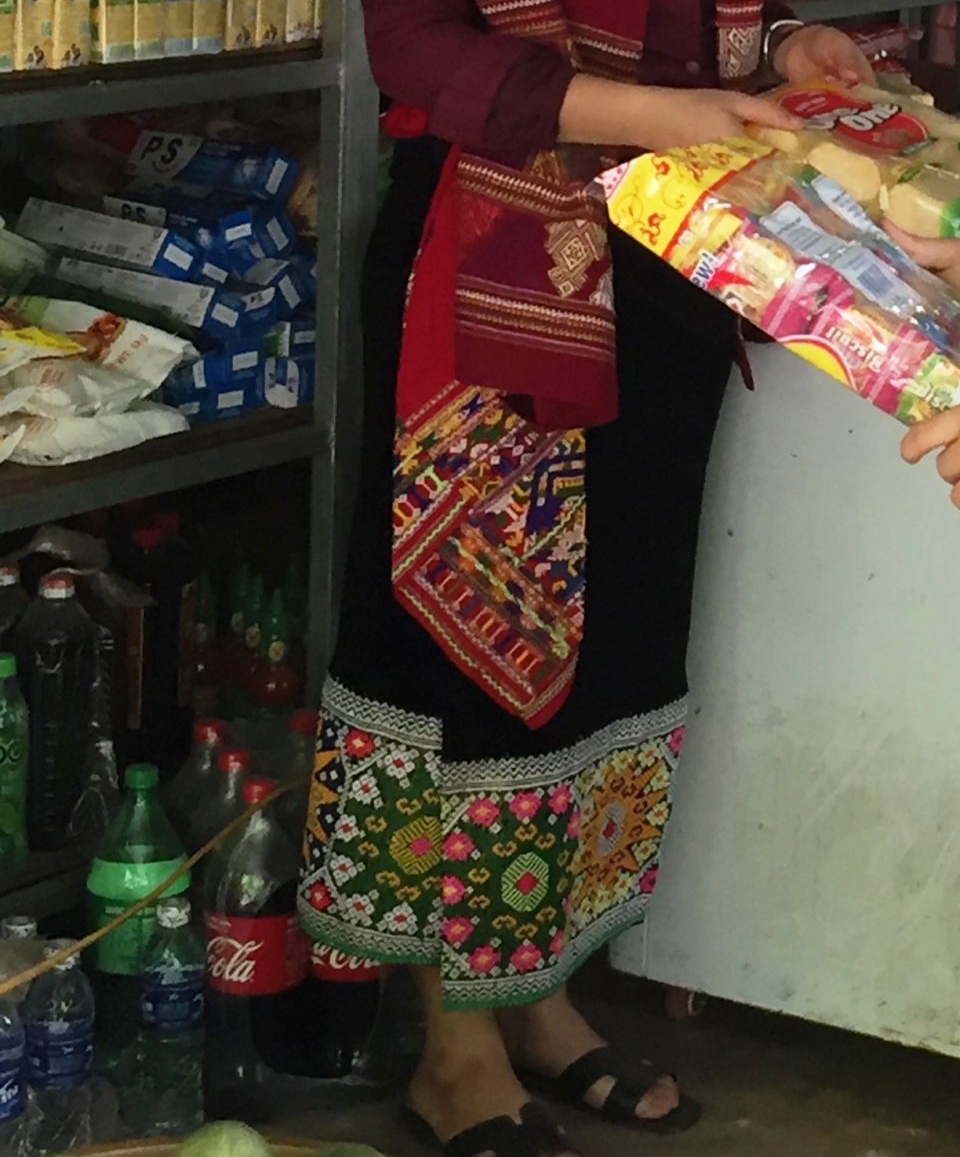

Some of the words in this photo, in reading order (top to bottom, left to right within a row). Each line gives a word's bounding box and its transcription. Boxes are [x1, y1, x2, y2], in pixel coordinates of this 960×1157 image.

[140, 135, 184, 165] PS
[692, 252, 718, 288] ew!
[825, 326, 885, 371] Biscuit
